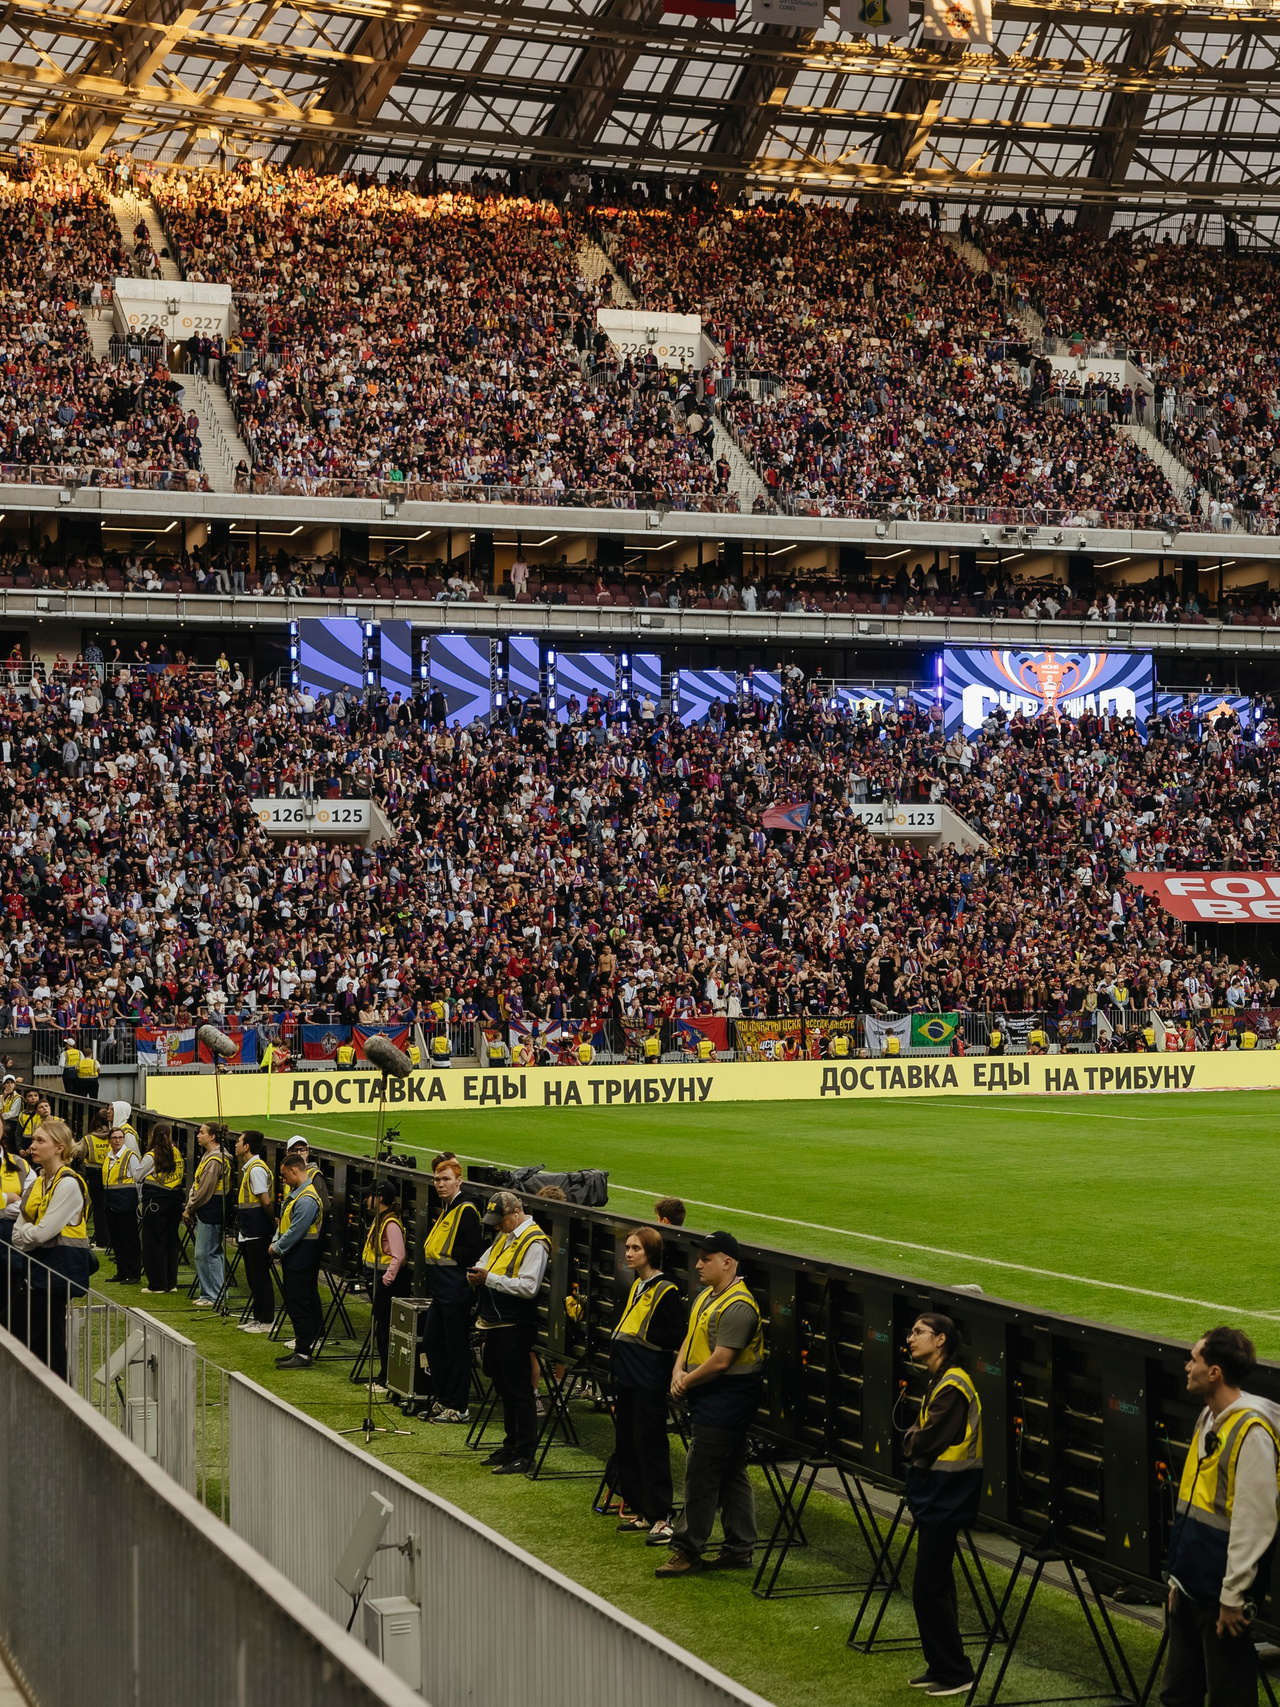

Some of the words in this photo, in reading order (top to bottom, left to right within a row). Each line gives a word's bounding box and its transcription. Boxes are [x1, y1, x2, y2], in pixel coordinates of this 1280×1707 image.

[141, 313, 169, 327] 228
[194, 317, 222, 329] 227
[621, 343, 647, 355] 226
[669, 346, 694, 358] 225
[1098, 372, 1120, 383] 223
[272, 808, 304, 823] 126
[332, 808, 363, 823] 125
[908, 813, 935, 826] 123
[820, 1064, 958, 1096] ДОСТАВКА
[973, 1062, 1029, 1091] ЕДЫ
[1045, 1067, 1079, 1091] НА
[1084, 1065, 1195, 1090] ТРИБУНУ
[290, 1076, 447, 1111] ДОСТАВКА
[463, 1074, 527, 1105] ЕДЫ
[544, 1080, 582, 1106] НА
[588, 1077, 713, 1105] ТРИБУНУ
